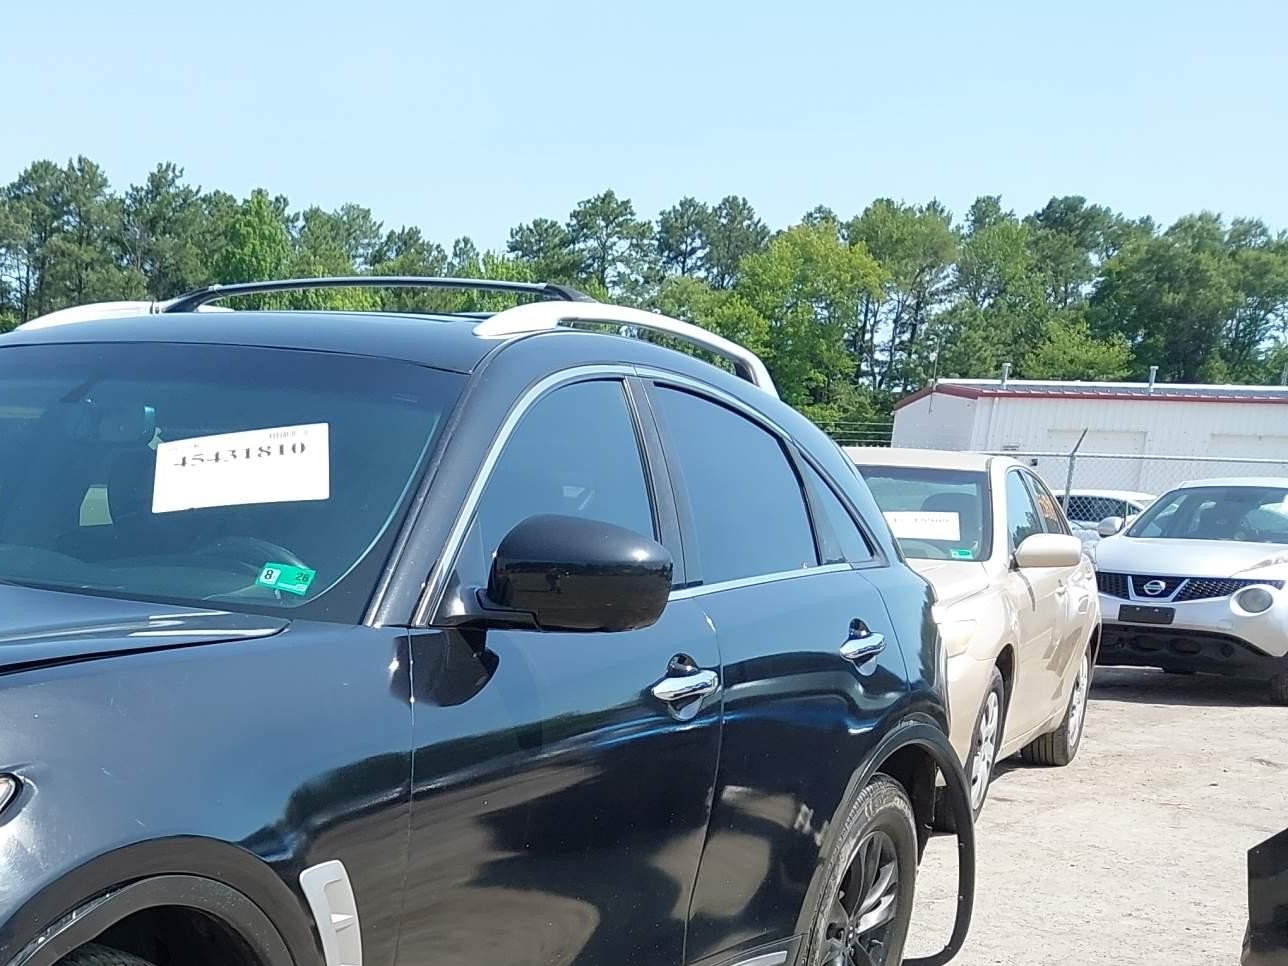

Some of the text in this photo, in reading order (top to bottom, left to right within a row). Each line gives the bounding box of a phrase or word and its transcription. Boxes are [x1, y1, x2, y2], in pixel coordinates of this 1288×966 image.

[173, 442, 306, 467] 45431810
[264, 569, 274, 580] 8
[295, 572, 311, 583] 26
